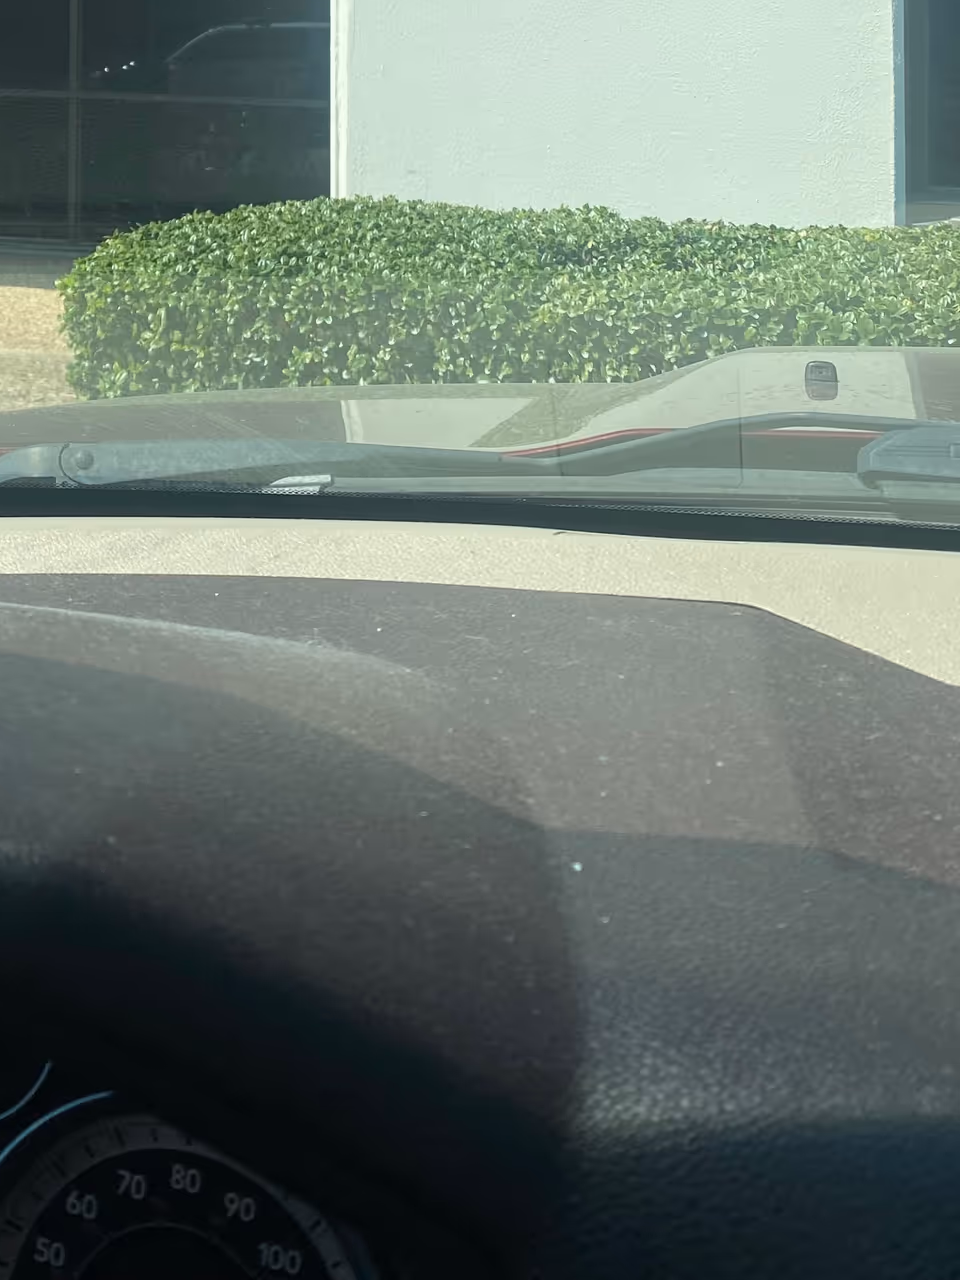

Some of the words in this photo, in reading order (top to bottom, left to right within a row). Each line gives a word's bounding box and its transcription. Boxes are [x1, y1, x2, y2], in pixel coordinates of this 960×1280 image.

[114, 1167, 148, 1201] 70
[168, 1163, 202, 1195] 80
[65, 1189, 99, 1221] 60
[224, 1191, 258, 1223] 90
[32, 1236, 66, 1269] 50
[256, 1241, 303, 1275] 100
